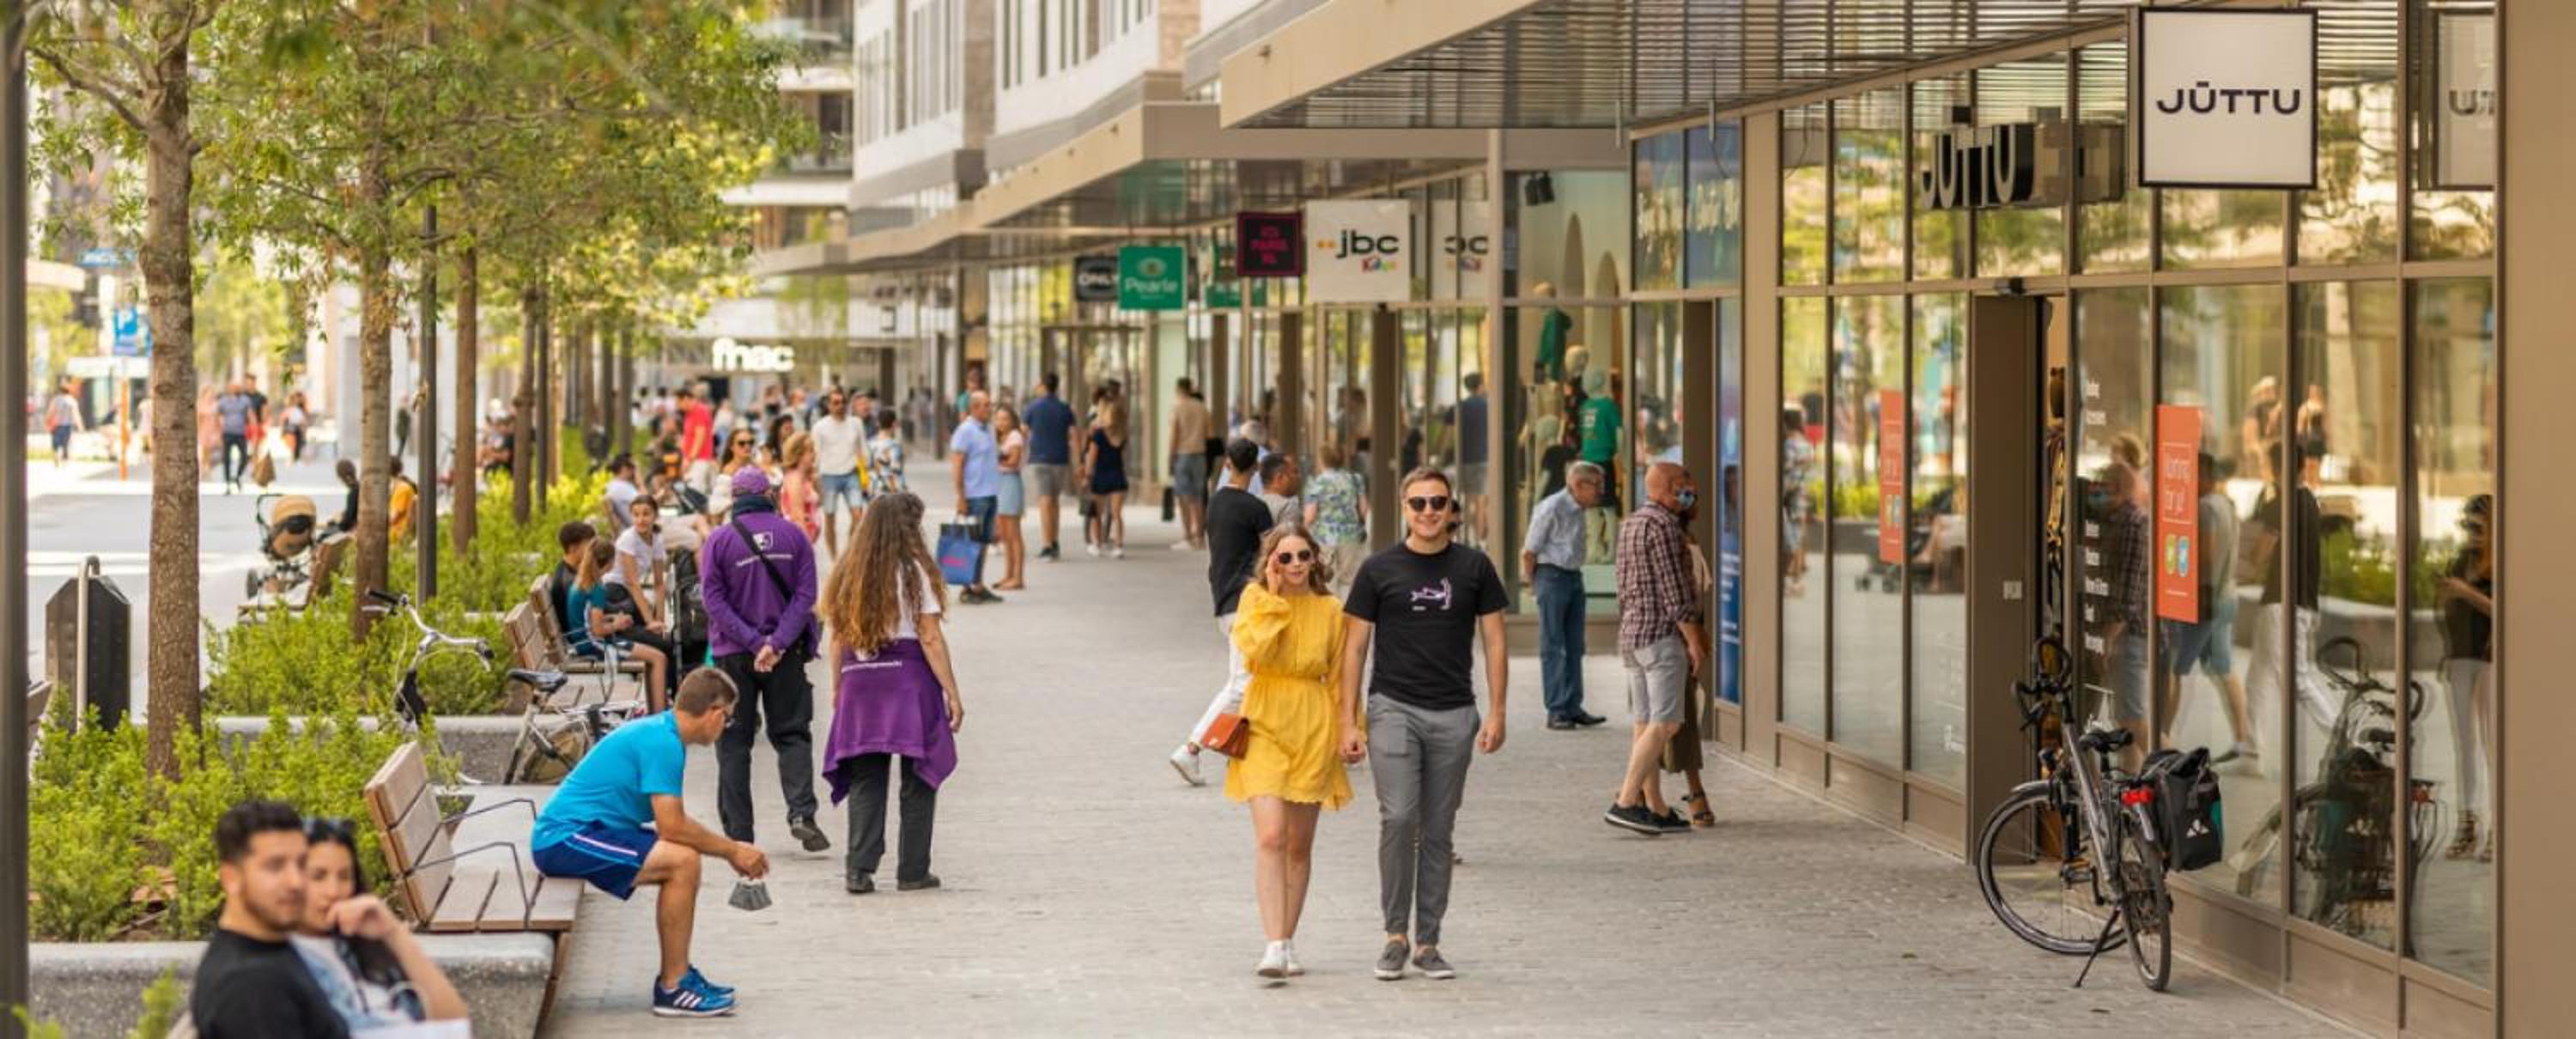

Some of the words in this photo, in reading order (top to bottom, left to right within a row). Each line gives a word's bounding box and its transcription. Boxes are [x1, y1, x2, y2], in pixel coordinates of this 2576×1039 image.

[2157, 81, 2300, 114] JŪTTU
[1336, 229, 1400, 259] jbc
[1126, 276, 1178, 293] Pearle
[713, 337, 794, 372] fnac
